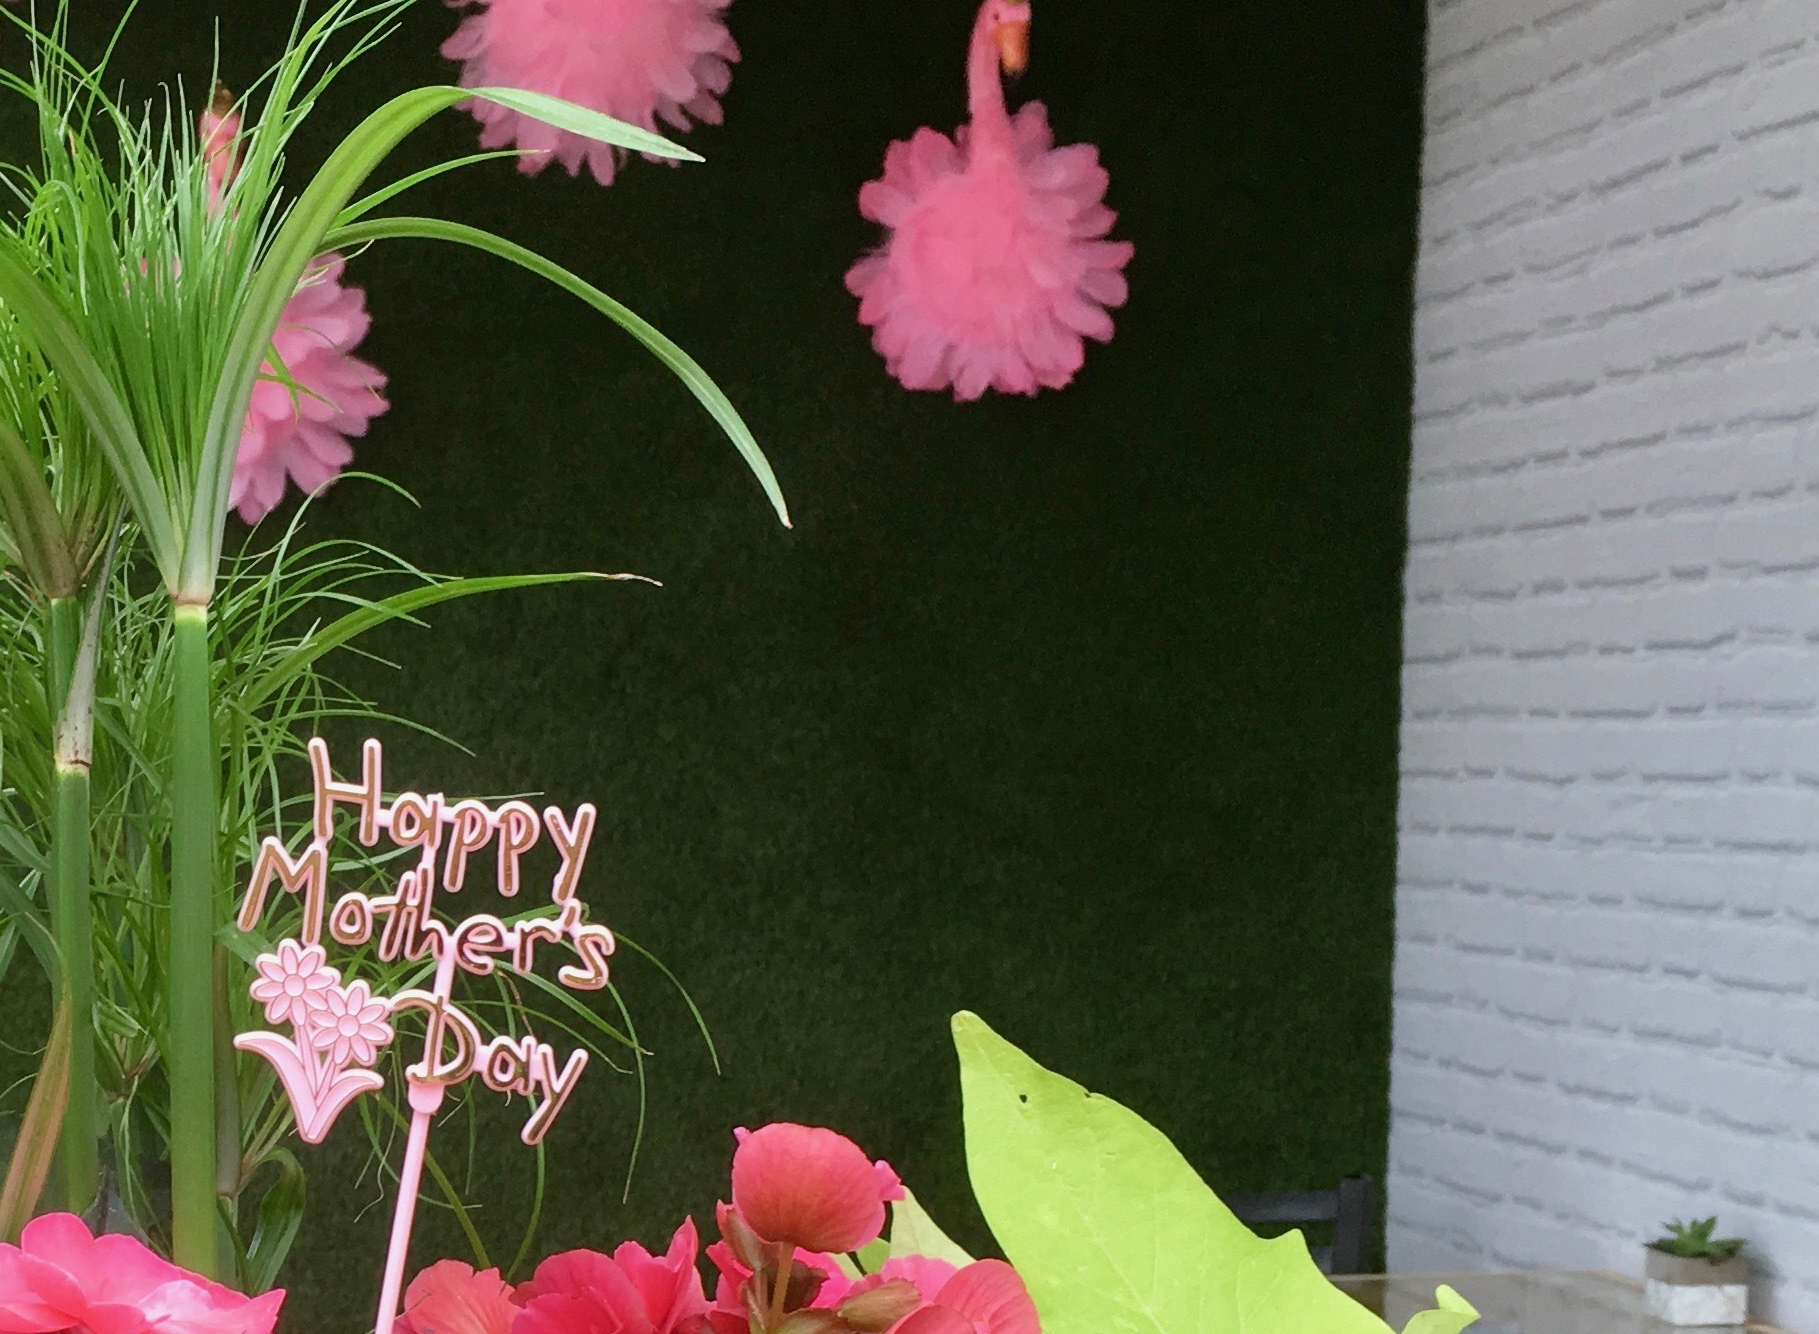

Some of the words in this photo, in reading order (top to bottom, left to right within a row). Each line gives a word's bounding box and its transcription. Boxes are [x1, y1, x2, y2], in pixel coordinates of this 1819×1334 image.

[308, 737, 597, 904] Happy
[237, 836, 616, 990] Mother's
[389, 990, 589, 1146] Day
